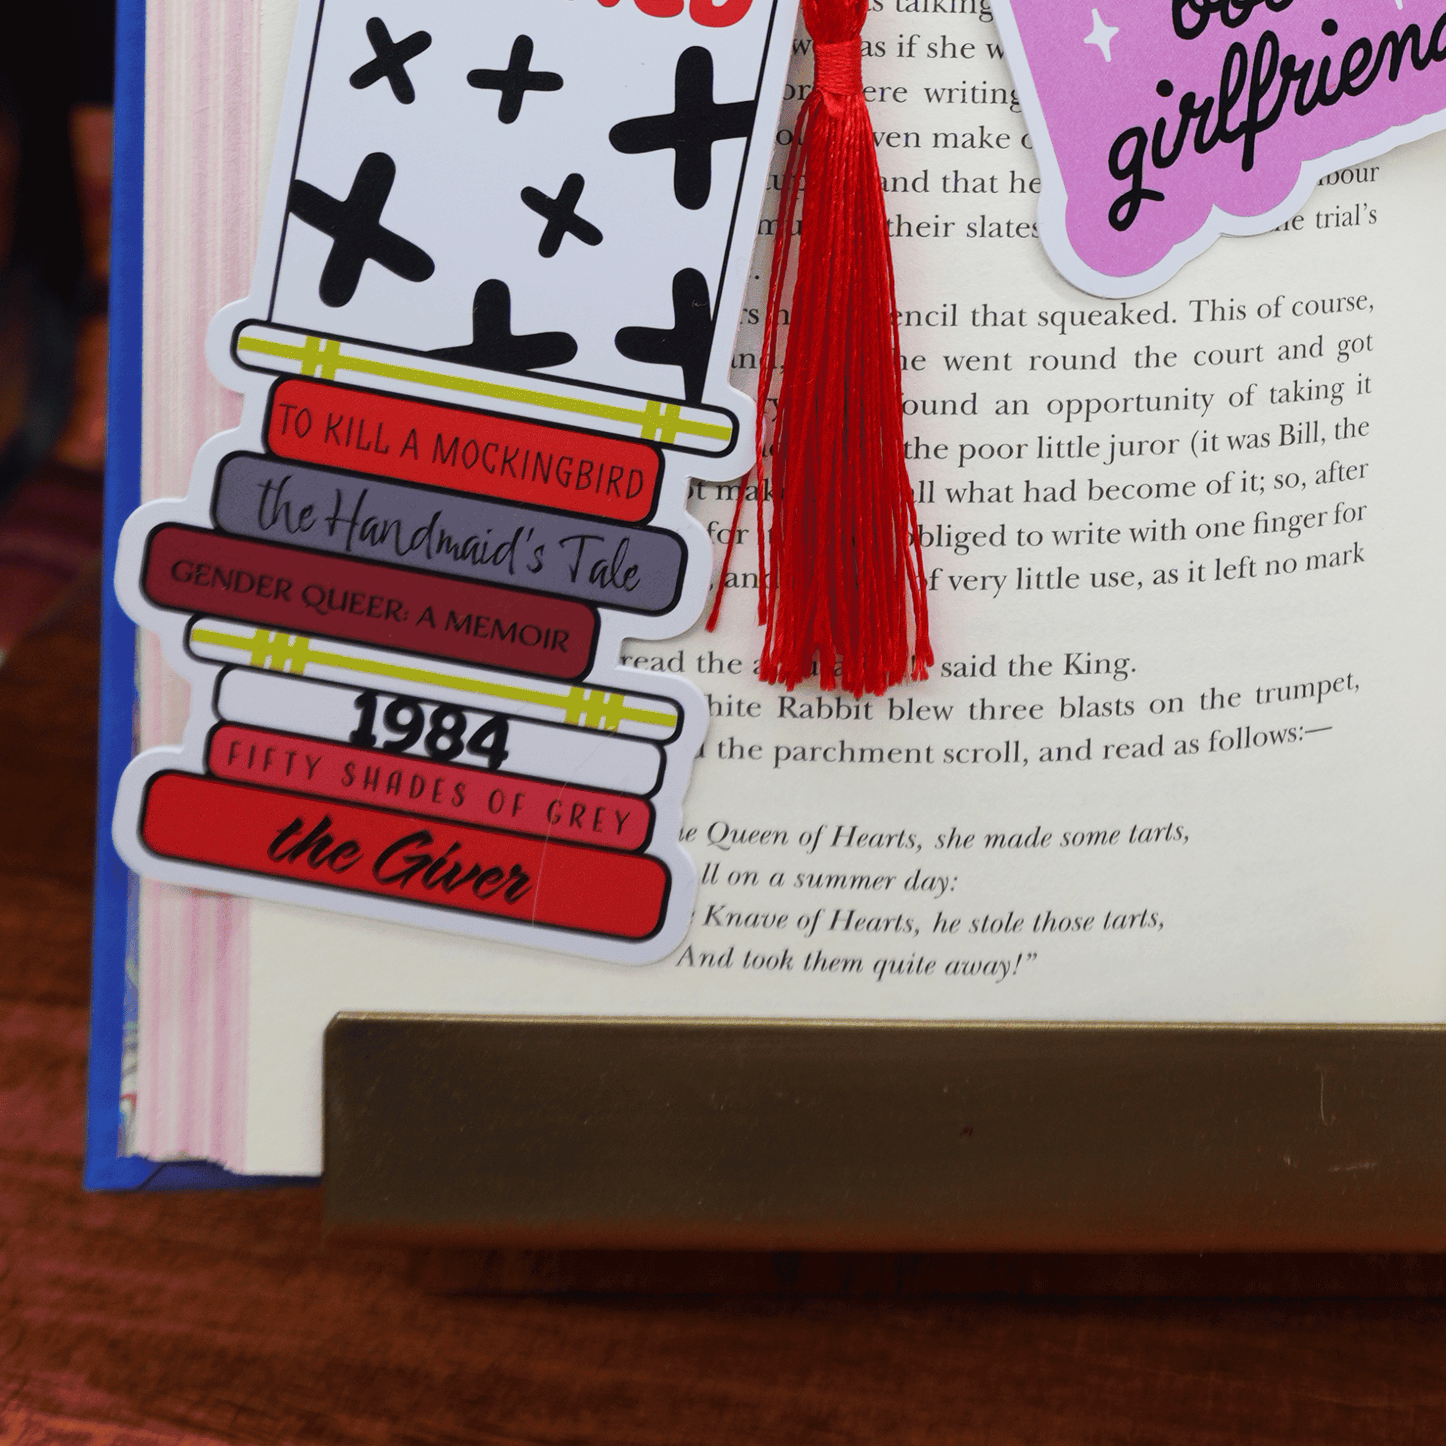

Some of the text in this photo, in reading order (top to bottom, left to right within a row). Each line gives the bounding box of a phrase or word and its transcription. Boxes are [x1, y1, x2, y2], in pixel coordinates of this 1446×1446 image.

[896, 33, 976, 60] if she
[931, 124, 1011, 150] make
[941, 169, 999, 194] that
[970, 294, 1374, 336] that squeaked. This of course,
[942, 333, 1374, 372] went round the court and got
[279, 403, 644, 501] TO KILL A MOCKINGBIRD
[903, 416, 1370, 469] the poor little juror (it was Bill, the
[257, 475, 641, 592] the Handmaid's Tale
[947, 540, 1365, 600] very little use, as it left no mark
[171, 560, 569, 653] GENDER QUEER: A MEMOIR
[940, 653, 997, 679] said
[1008, 653, 1053, 678] the
[1062, 651, 1137, 682] King.
[776, 672, 1360, 722] Rabbit blew three blasts on the trumpet,
[349, 692, 509, 771] 1984
[227, 740, 322, 779] FIFTY
[341, 762, 465, 808] SHADES
[487, 790, 526, 817] OF
[547, 800, 632, 836] GREY
[268, 815, 534, 903] the Giver
[706, 820, 789, 852] Queen
[798, 823, 828, 855] of
[829, 824, 923, 854] Hearts,
[934, 826, 976, 850] she
[983, 825, 1053, 849] made
[1059, 829, 1121, 848] some
[1128, 821, 1189, 845] tarts,
